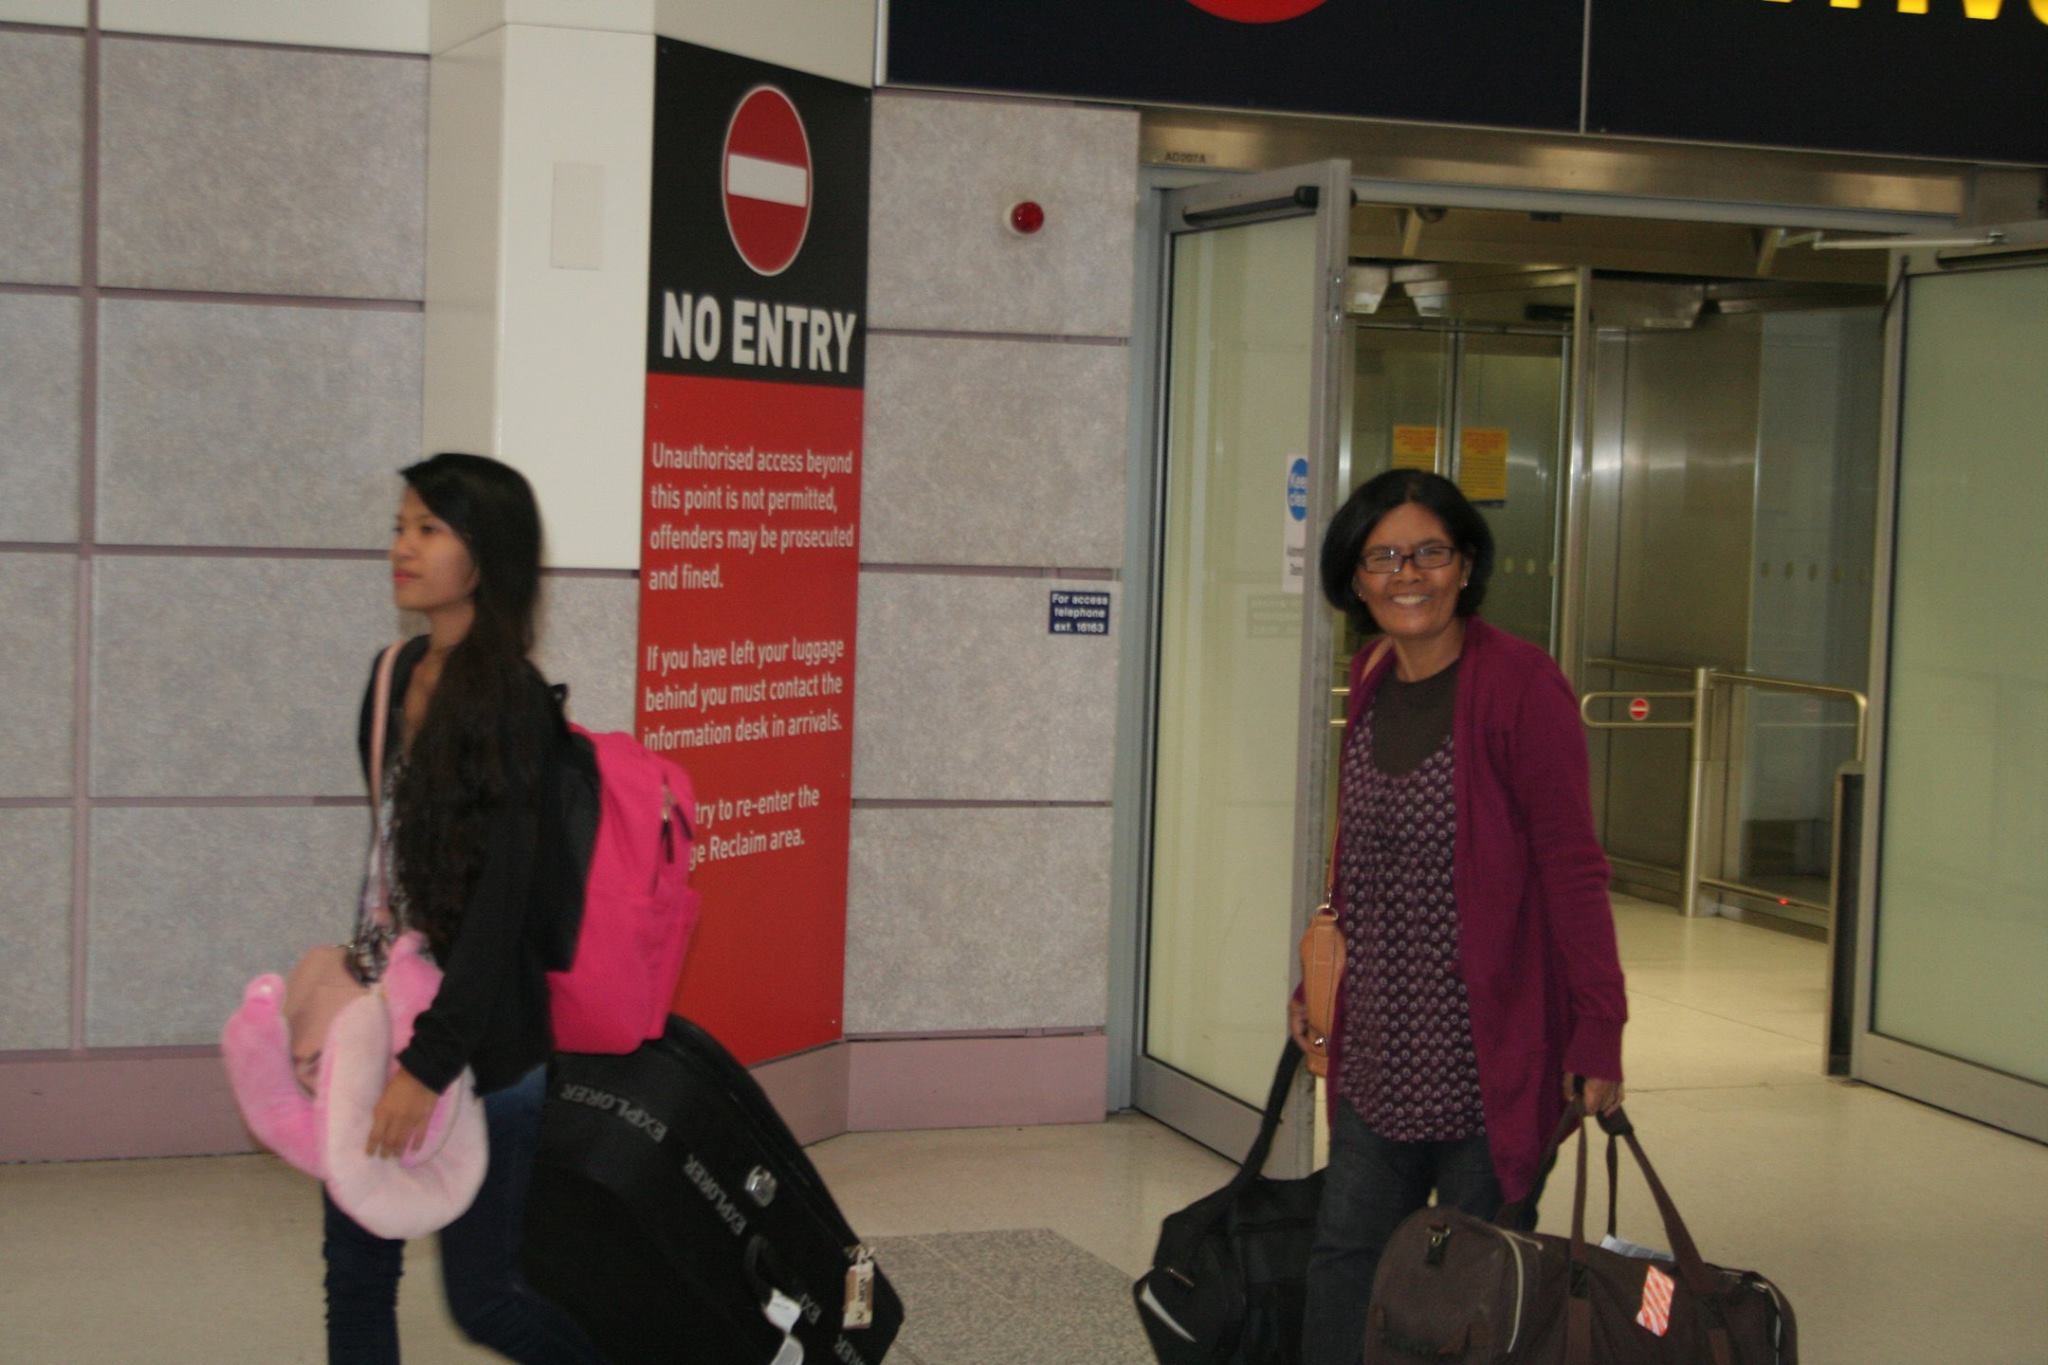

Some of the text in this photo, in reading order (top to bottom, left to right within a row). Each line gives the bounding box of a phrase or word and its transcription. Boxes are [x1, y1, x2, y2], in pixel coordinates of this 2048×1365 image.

[663, 290, 857, 373] NO ENTRY
[652, 443, 853, 479] Unauthorised access beyond
[651, 483, 837, 516] this point is not permitted,
[650, 524, 854, 554] offenders may be prosecuted
[649, 564, 724, 590] and fined.
[1052, 593, 1108, 605] For access
[1055, 607, 1105, 619] telephone
[647, 636, 844, 677] If you have left your luggage
[645, 671, 843, 713] behind you must contact the
[644, 708, 842, 751] information desk in arrivals.
[695, 784, 820, 829] try to re-enter the
[709, 830, 767, 861] Reclaim
[770, 828, 805, 850] area.
[560, 1083, 669, 1143] EXPLORER
[682, 1154, 747, 1236] EXPLORER
